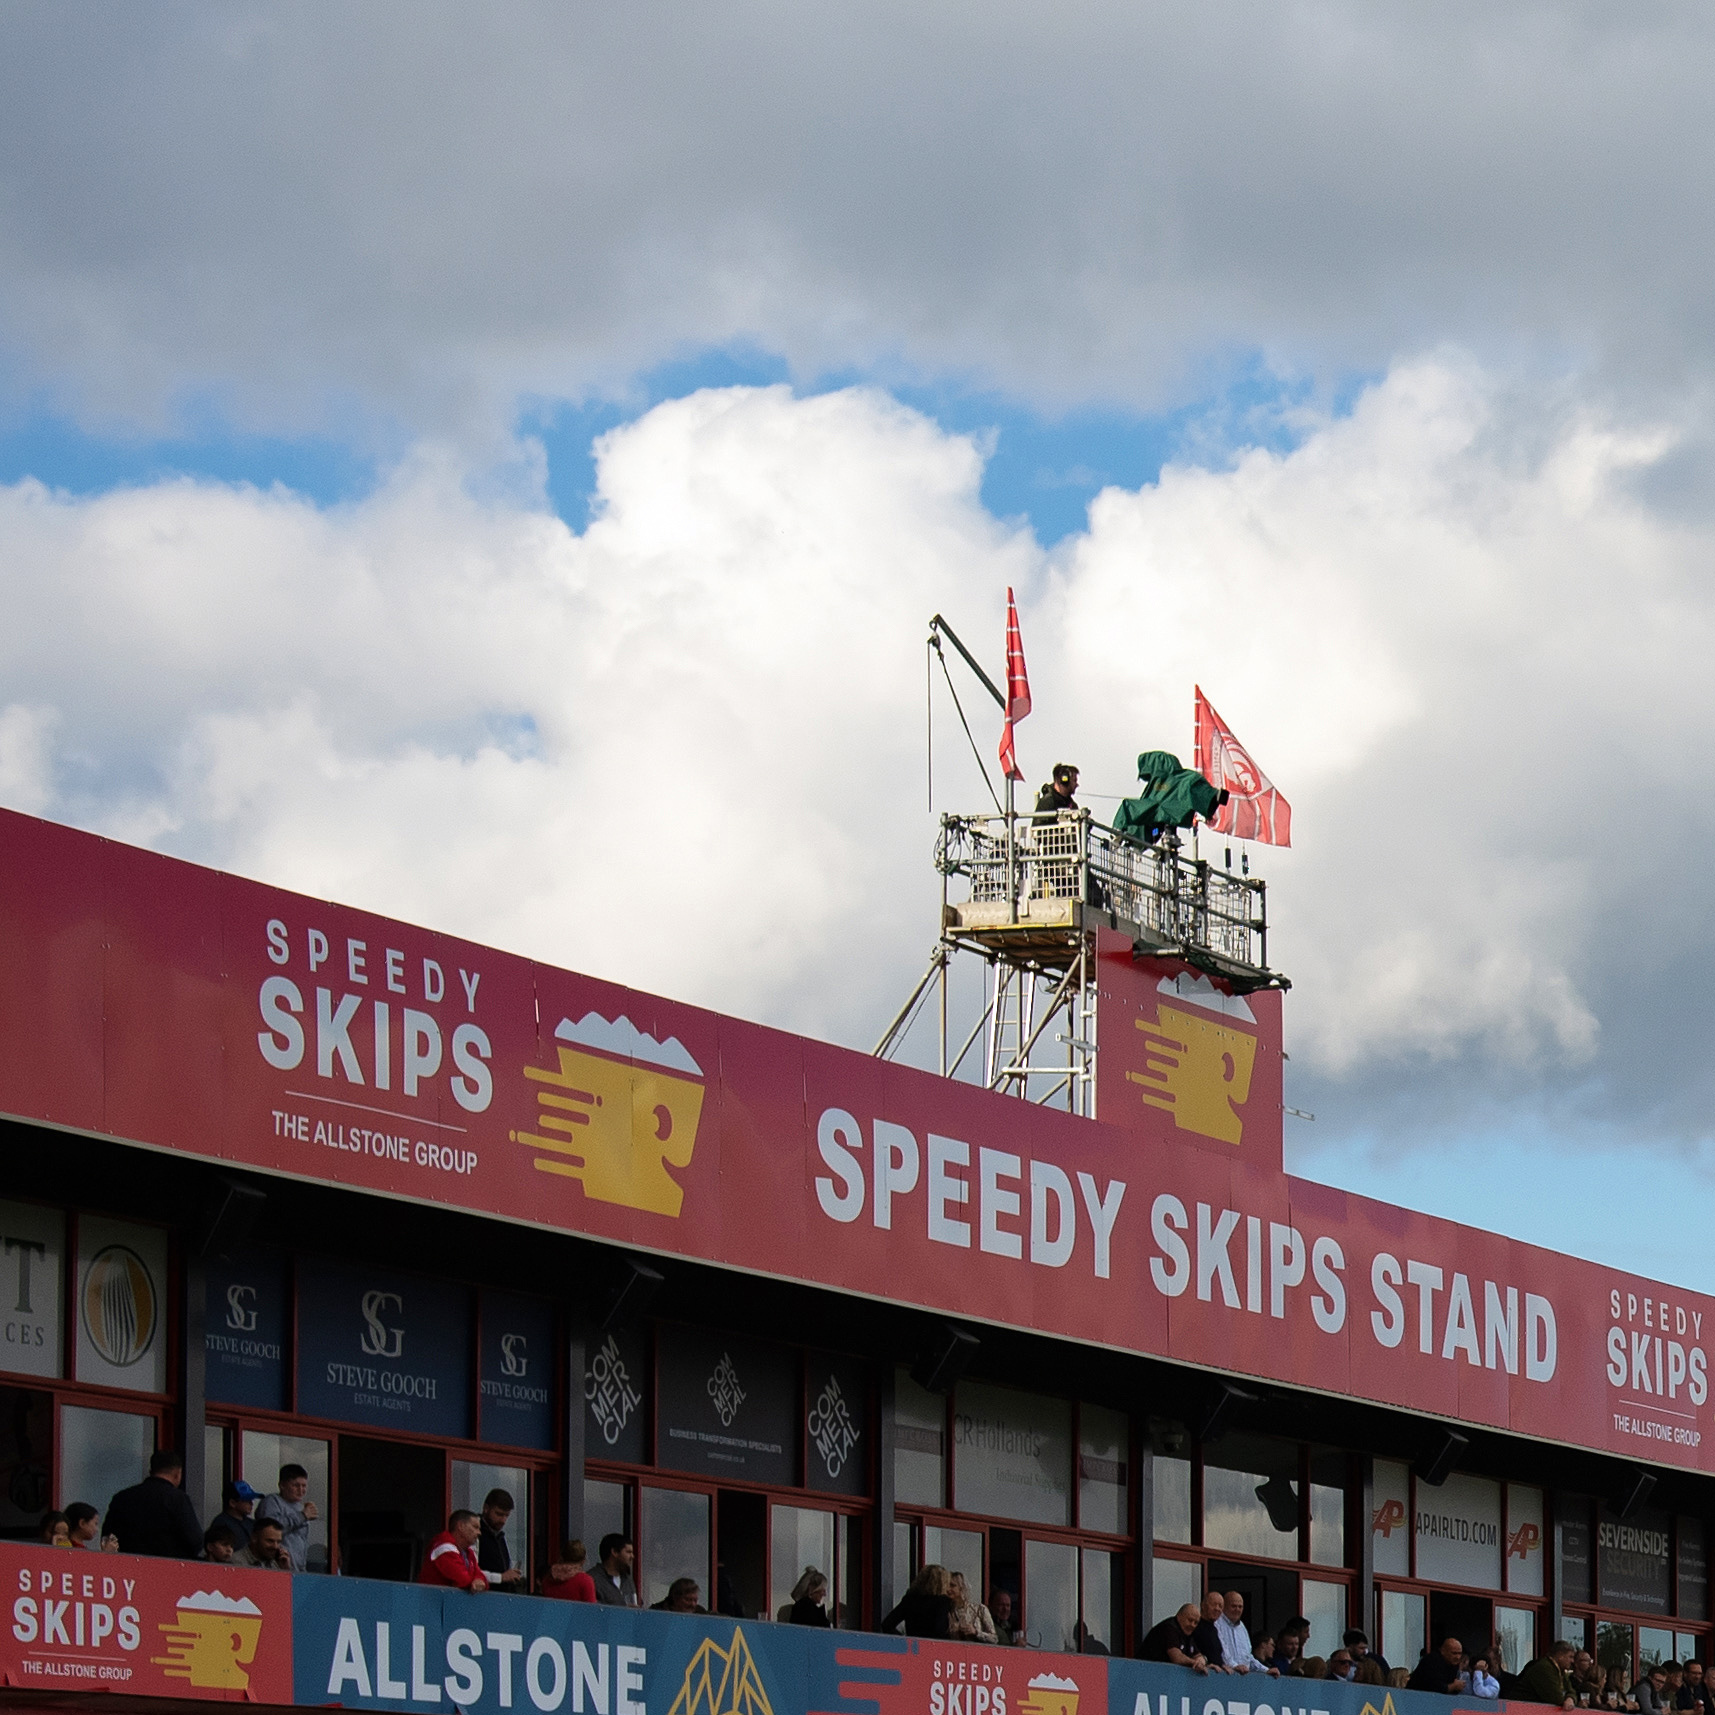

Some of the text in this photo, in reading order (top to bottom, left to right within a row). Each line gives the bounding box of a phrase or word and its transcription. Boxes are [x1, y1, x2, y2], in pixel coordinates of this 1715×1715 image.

[266, 918, 480, 1012] SPEEDY
[258, 975, 493, 1113] SKIPS
[272, 1111, 478, 1176] THE ALLSTONE GROUP
[815, 1106, 1558, 1383] SPEEDY SKIPS STAND
[1610, 1288, 1703, 1340] SPEEDY
[240, 1338, 281, 1361] GOOCH
[1606, 1326, 1708, 1405] SKIPS
[326, 1362, 437, 1400] STEVE GOOCH
[480, 1379, 512, 1400] STEVE
[513, 1384, 548, 1404] GOOCH
[808, 1374, 842, 1438] COM
[815, 1400, 850, 1461] MER
[826, 1419, 861, 1479] CIAL
[974, 1414, 1042, 1459] Hollands
[1630, 1416, 1701, 1448] ALLSTONE GROUP
[1416, 1511, 1498, 1547] APAIRLTD.COM
[1599, 1521, 1669, 1558] SEVERNSIDE
[19, 1569, 136, 1601] SPEEDY
[12, 1597, 141, 1651] SKIPS
[22, 1660, 133, 1682] THE ALLSTONE GROUP
[933, 1659, 1004, 1683] SPEEDY
